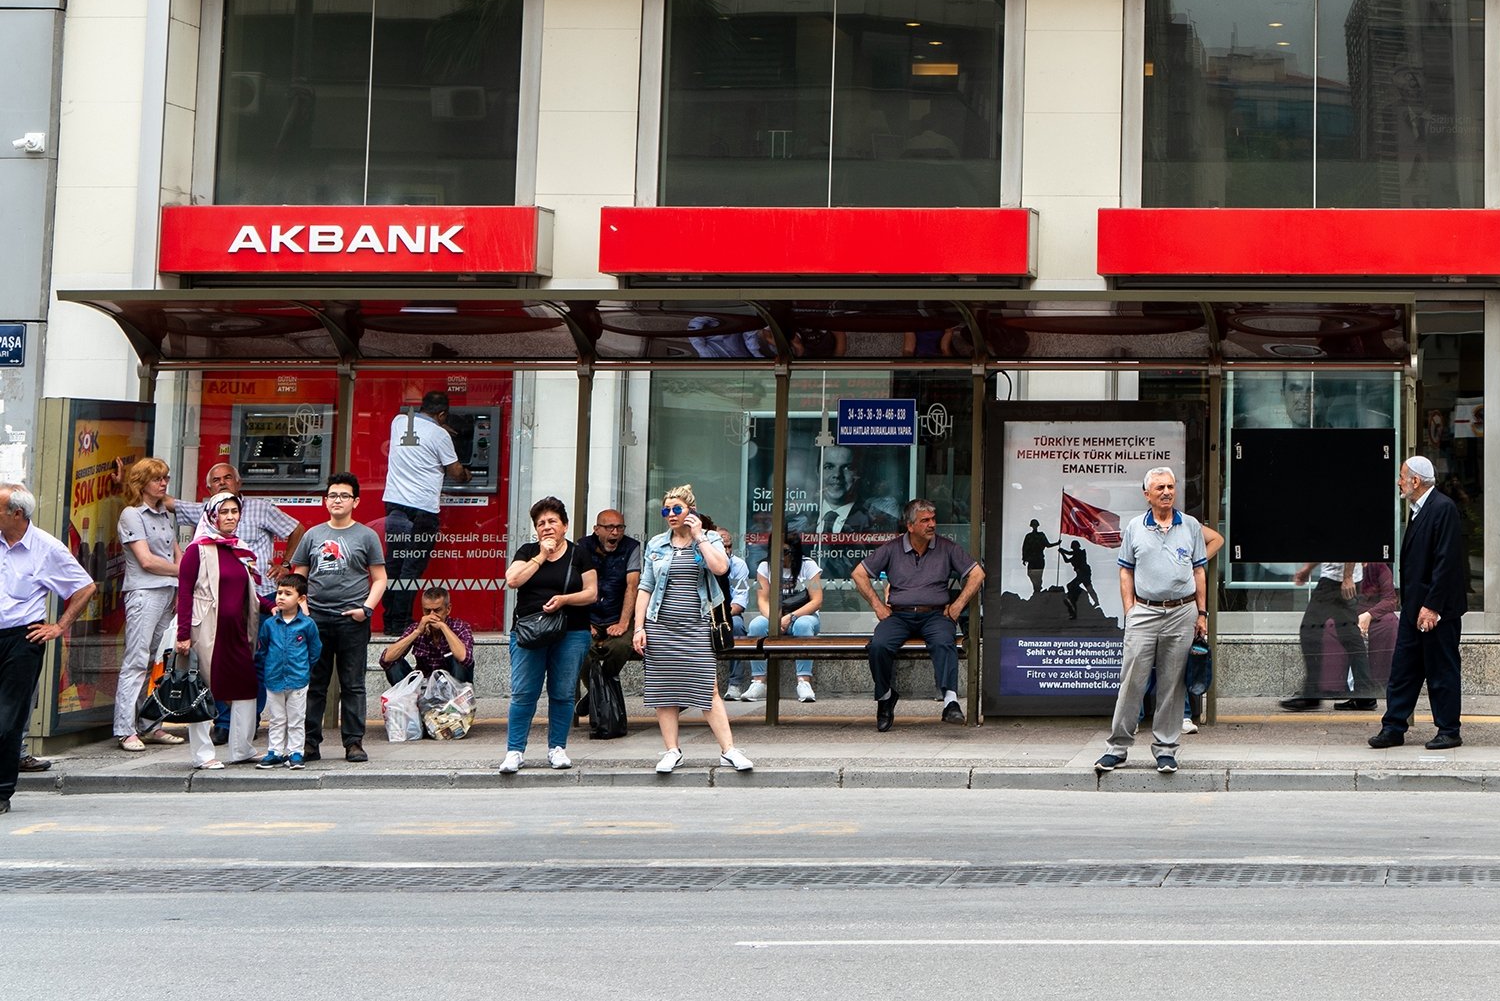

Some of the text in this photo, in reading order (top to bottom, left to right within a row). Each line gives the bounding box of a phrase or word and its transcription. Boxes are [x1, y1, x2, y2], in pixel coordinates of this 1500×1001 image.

[228, 224, 464, 254] AKBANK
[1034, 435, 1079, 447] TÜRKİYE
[1017, 449, 1170, 461] MEHMETÇİK TÜRK MİLLETİNE
[1062, 463, 1127, 474] EMANETTİR.
[753, 487, 807, 500] Sizi için
[752, 500, 818, 514] burayım
[385, 532, 538, 544] İZMİR BÜYÜKŞEHİR BELEDYES
[393, 548, 514, 559] ESHOT GENEL MÜDÜRL
[811, 550, 874, 559] ESHOT GENE
[1053, 640, 1078, 649] ayında
[1026, 648, 1045, 656] Şehit
[1057, 648, 1073, 656] Gazi
[1075, 648, 1115, 656] Mehmetçik
[1027, 670, 1046, 678] Fitre
[1060, 670, 1082, 678] zekât
[1085, 670, 1120, 680] bağışları
[1039, 681, 1121, 689] www.mehmetcik.or
